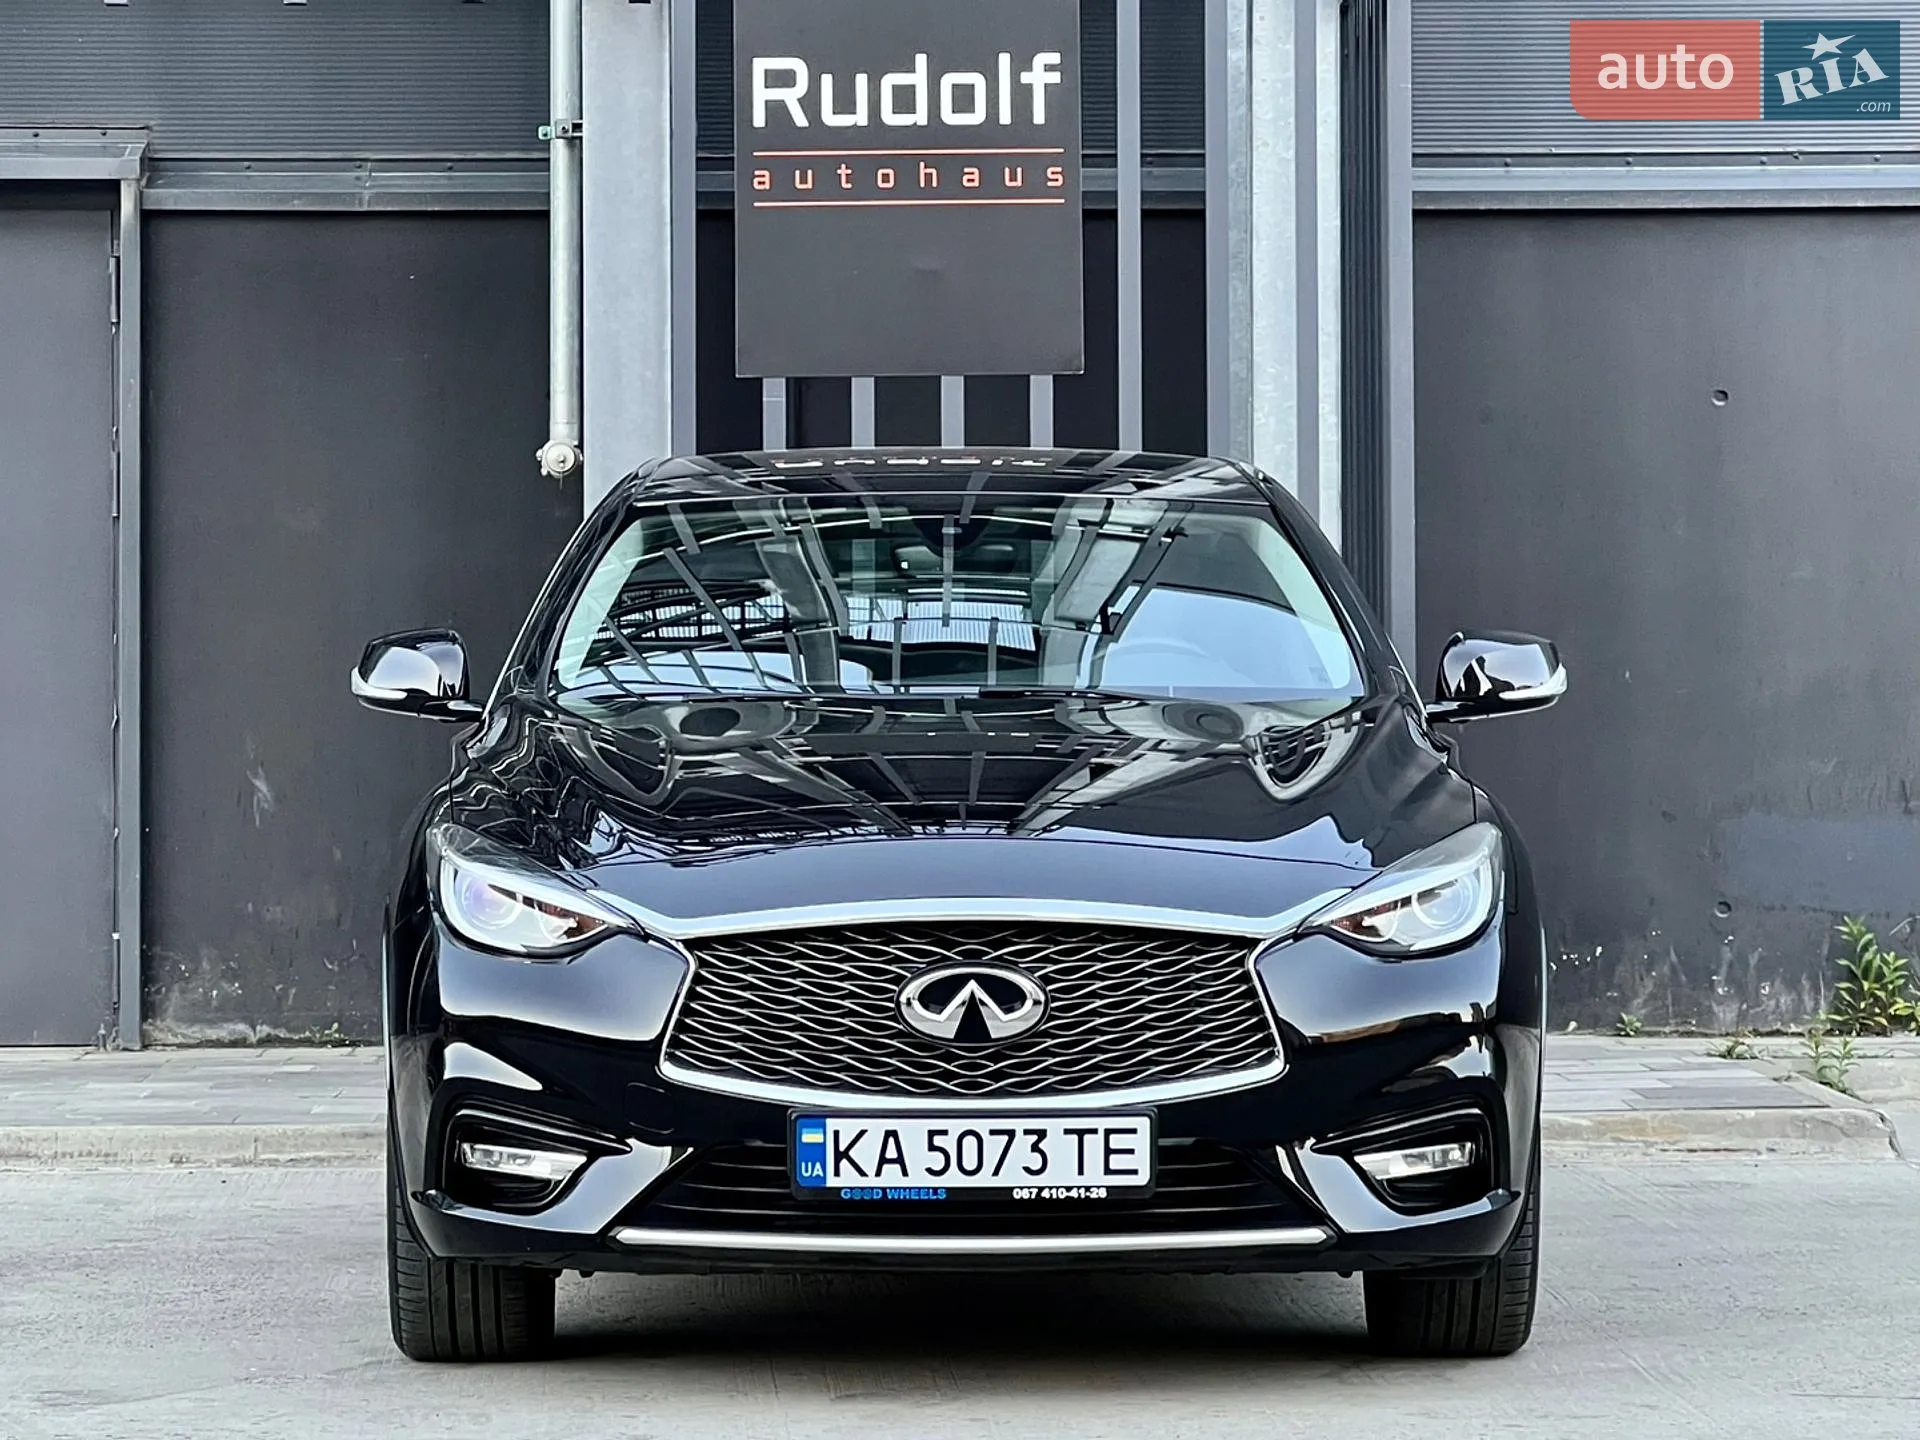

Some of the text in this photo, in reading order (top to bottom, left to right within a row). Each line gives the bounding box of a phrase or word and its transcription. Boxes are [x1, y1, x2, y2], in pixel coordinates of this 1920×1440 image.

[752, 52, 1062, 128] Rudolf
[753, 161, 1065, 191] autohaus
[832, 1127, 1139, 1178] KA 5073 TE
[801, 1162, 824, 1178] UA
[886, 1188, 947, 1200] WHEELS
[1012, 1187, 1038, 1199] 067
